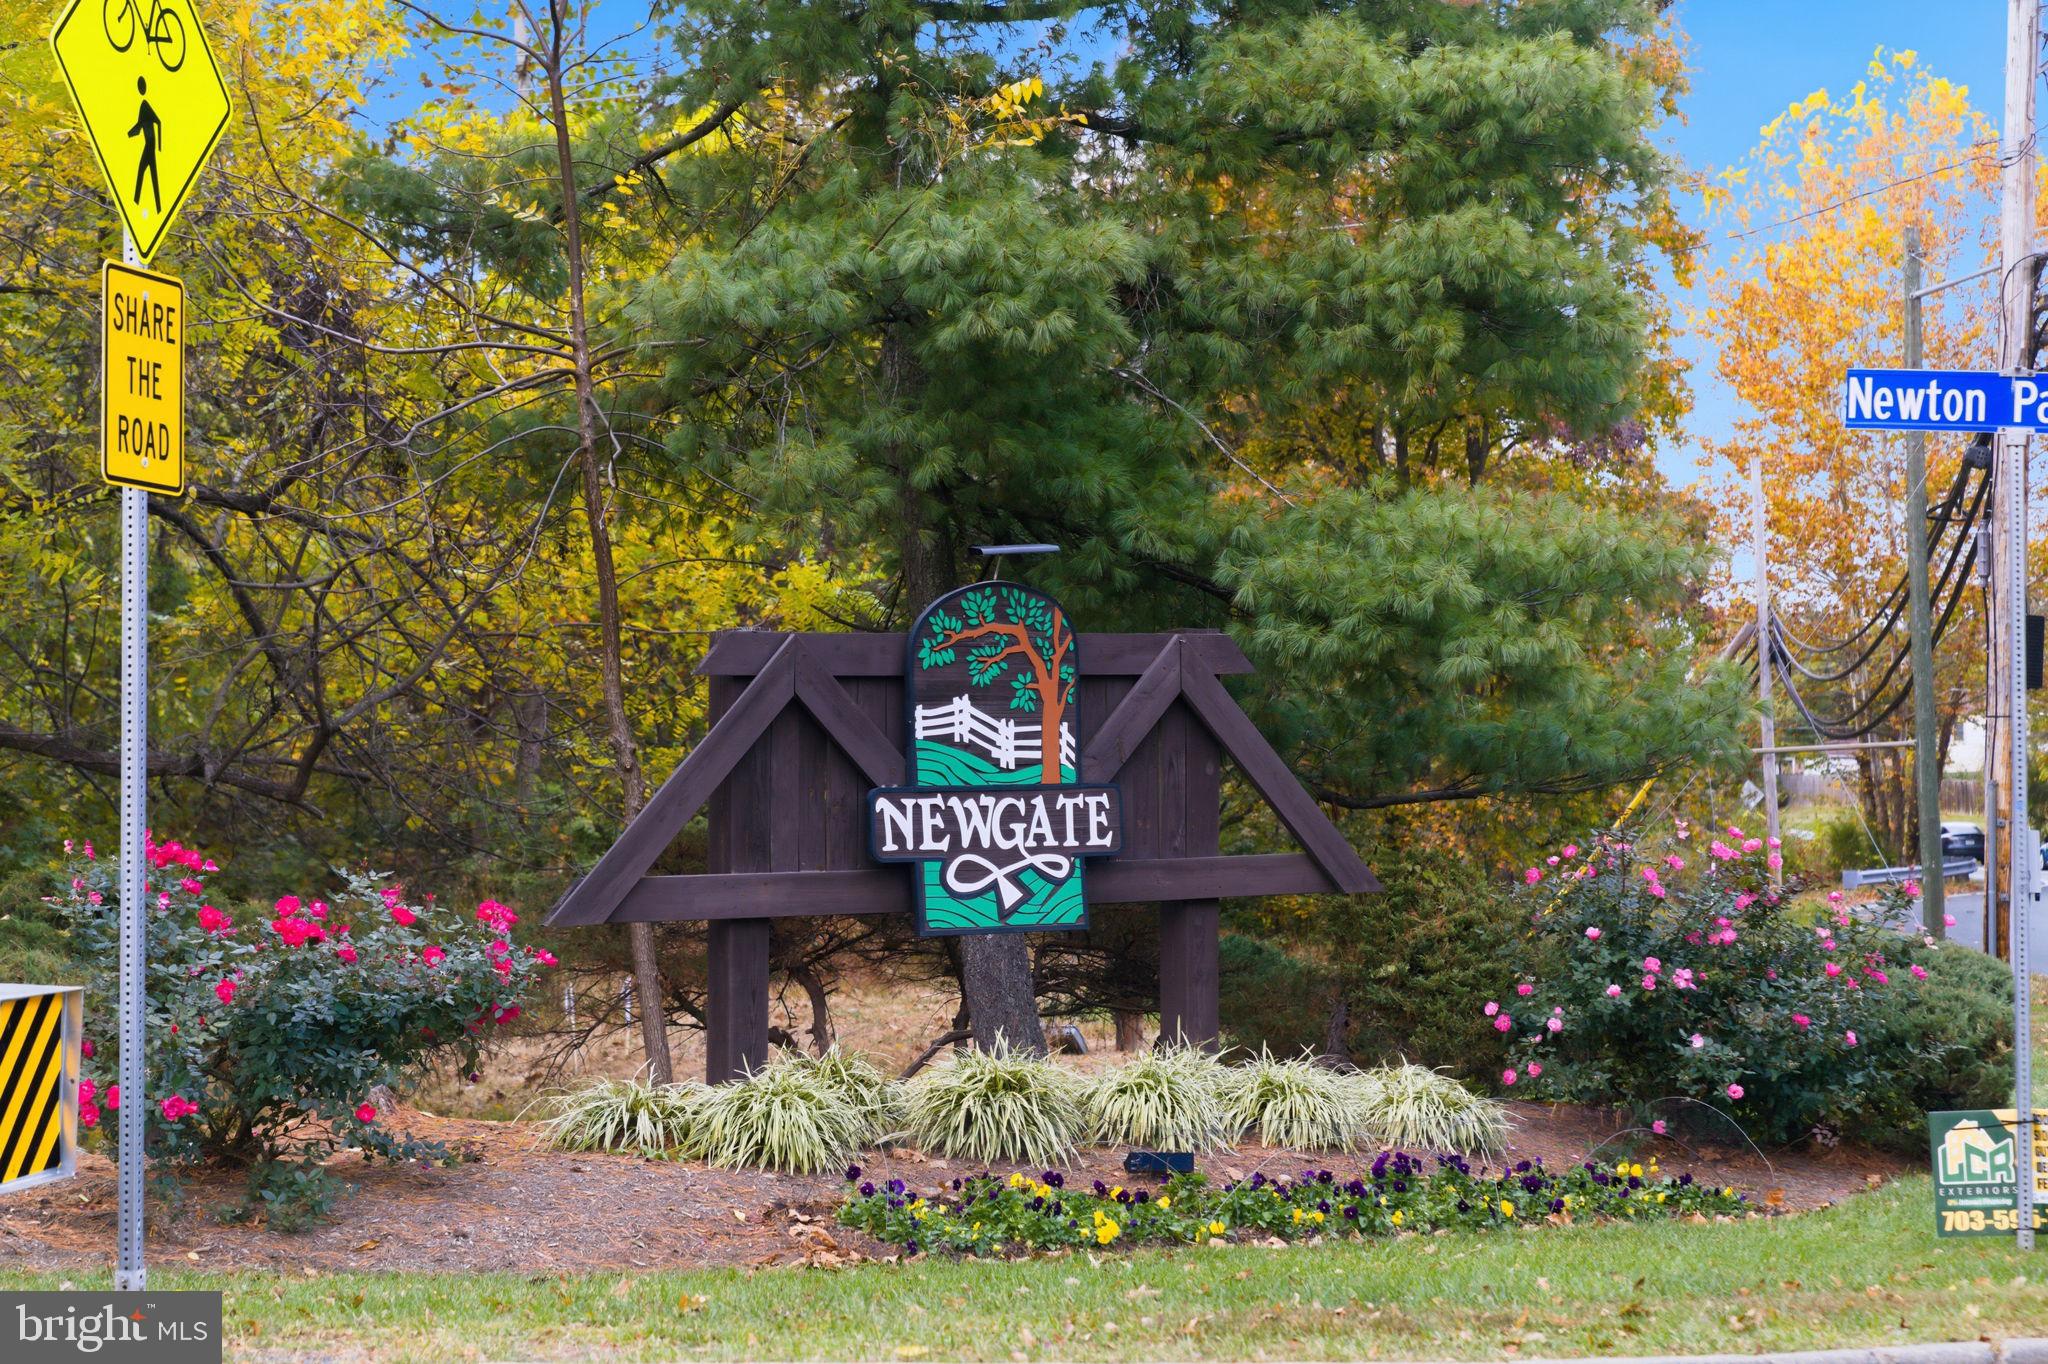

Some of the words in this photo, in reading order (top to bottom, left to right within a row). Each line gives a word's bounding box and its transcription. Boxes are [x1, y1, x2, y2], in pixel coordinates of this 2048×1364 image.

[113, 292, 176, 345] SHARE
[127, 356, 162, 400] THE
[1848, 377, 1986, 422] Newton
[2013, 380, 2048, 424] Pa
[118, 414, 169, 461] ROAD
[876, 793, 1113, 852] NEWGATE
[1938, 1138, 2016, 1185] LCR
[1939, 1186, 2018, 1196] EXTERIORS
